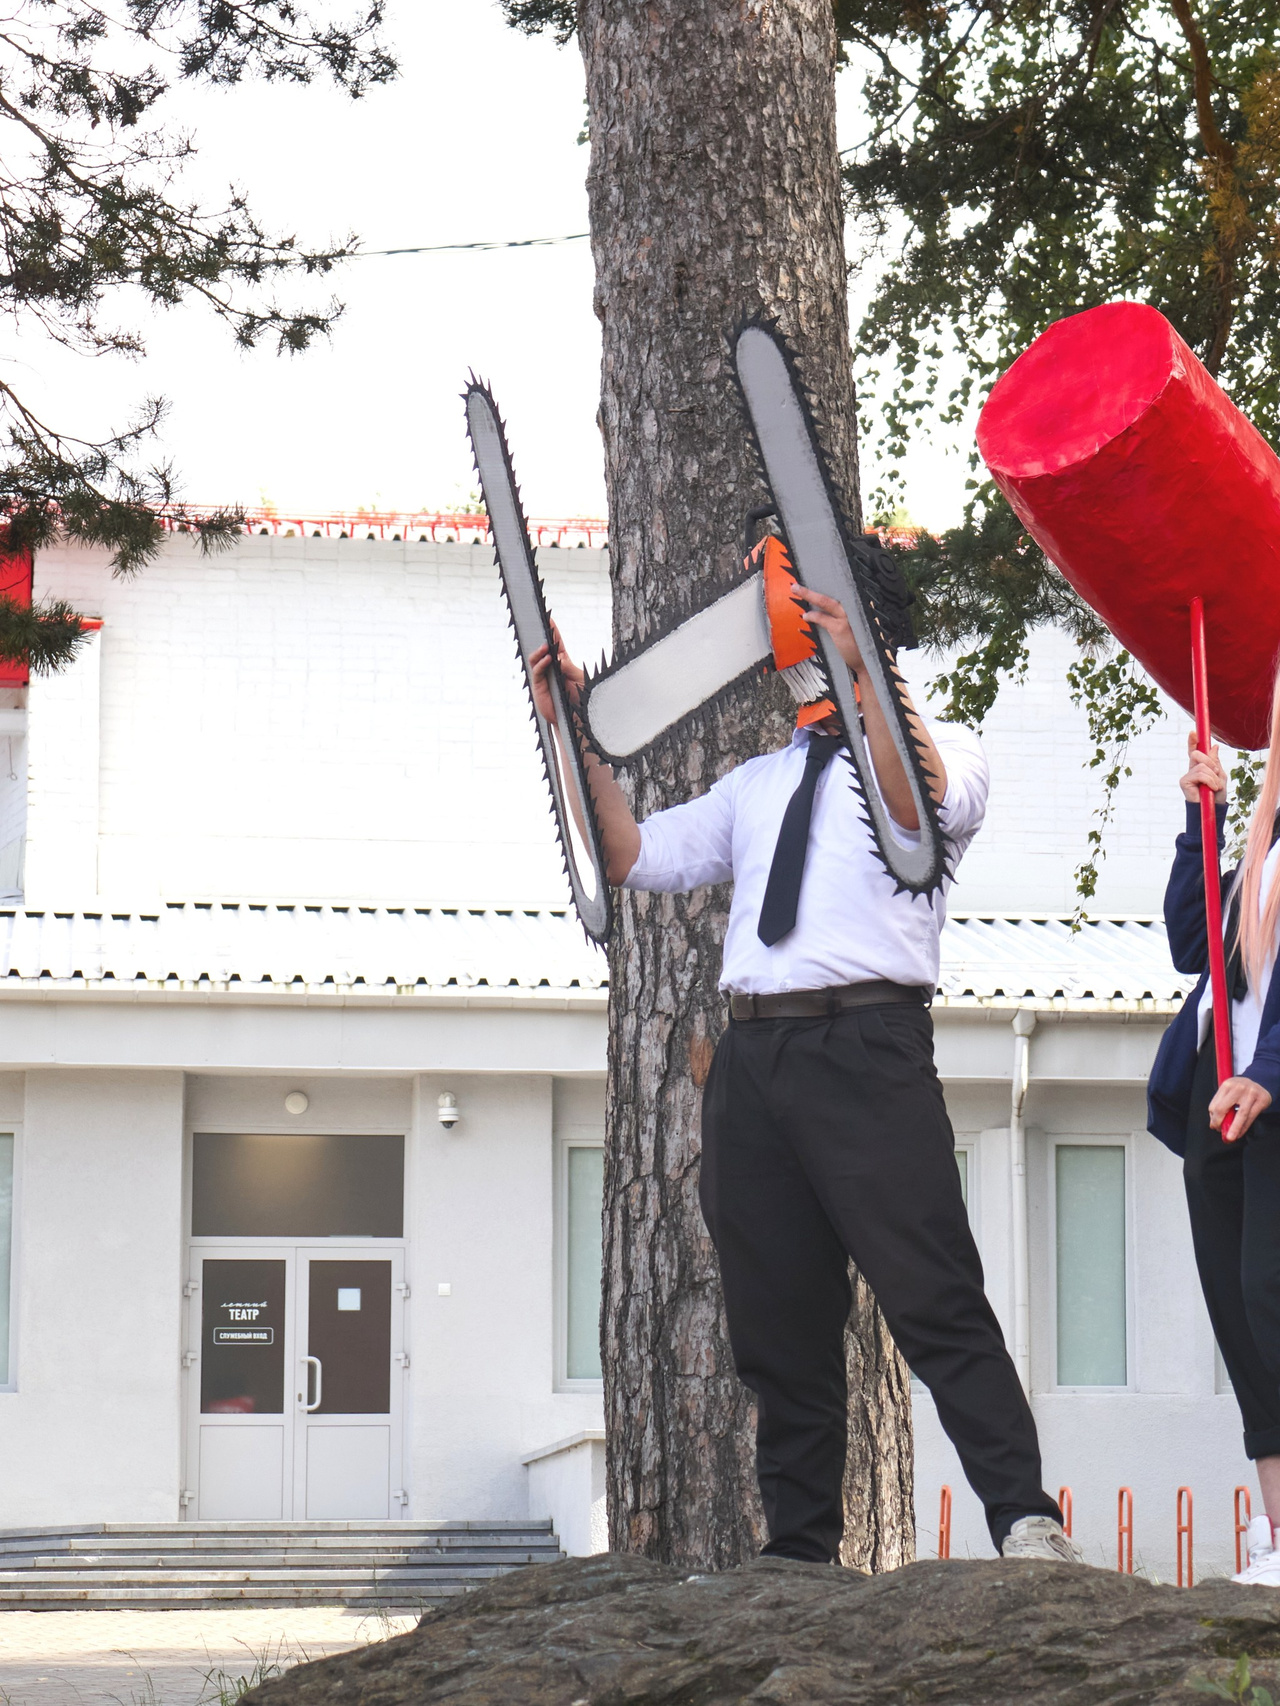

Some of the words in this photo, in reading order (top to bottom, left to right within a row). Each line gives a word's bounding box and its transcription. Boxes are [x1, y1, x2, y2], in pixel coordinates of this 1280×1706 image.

[228, 1308, 260, 1321] ТЕАТР
[219, 1332, 252, 1340] СЛУЖЕБНЫЙ
[253, 1332, 268, 1340] ВХОД
